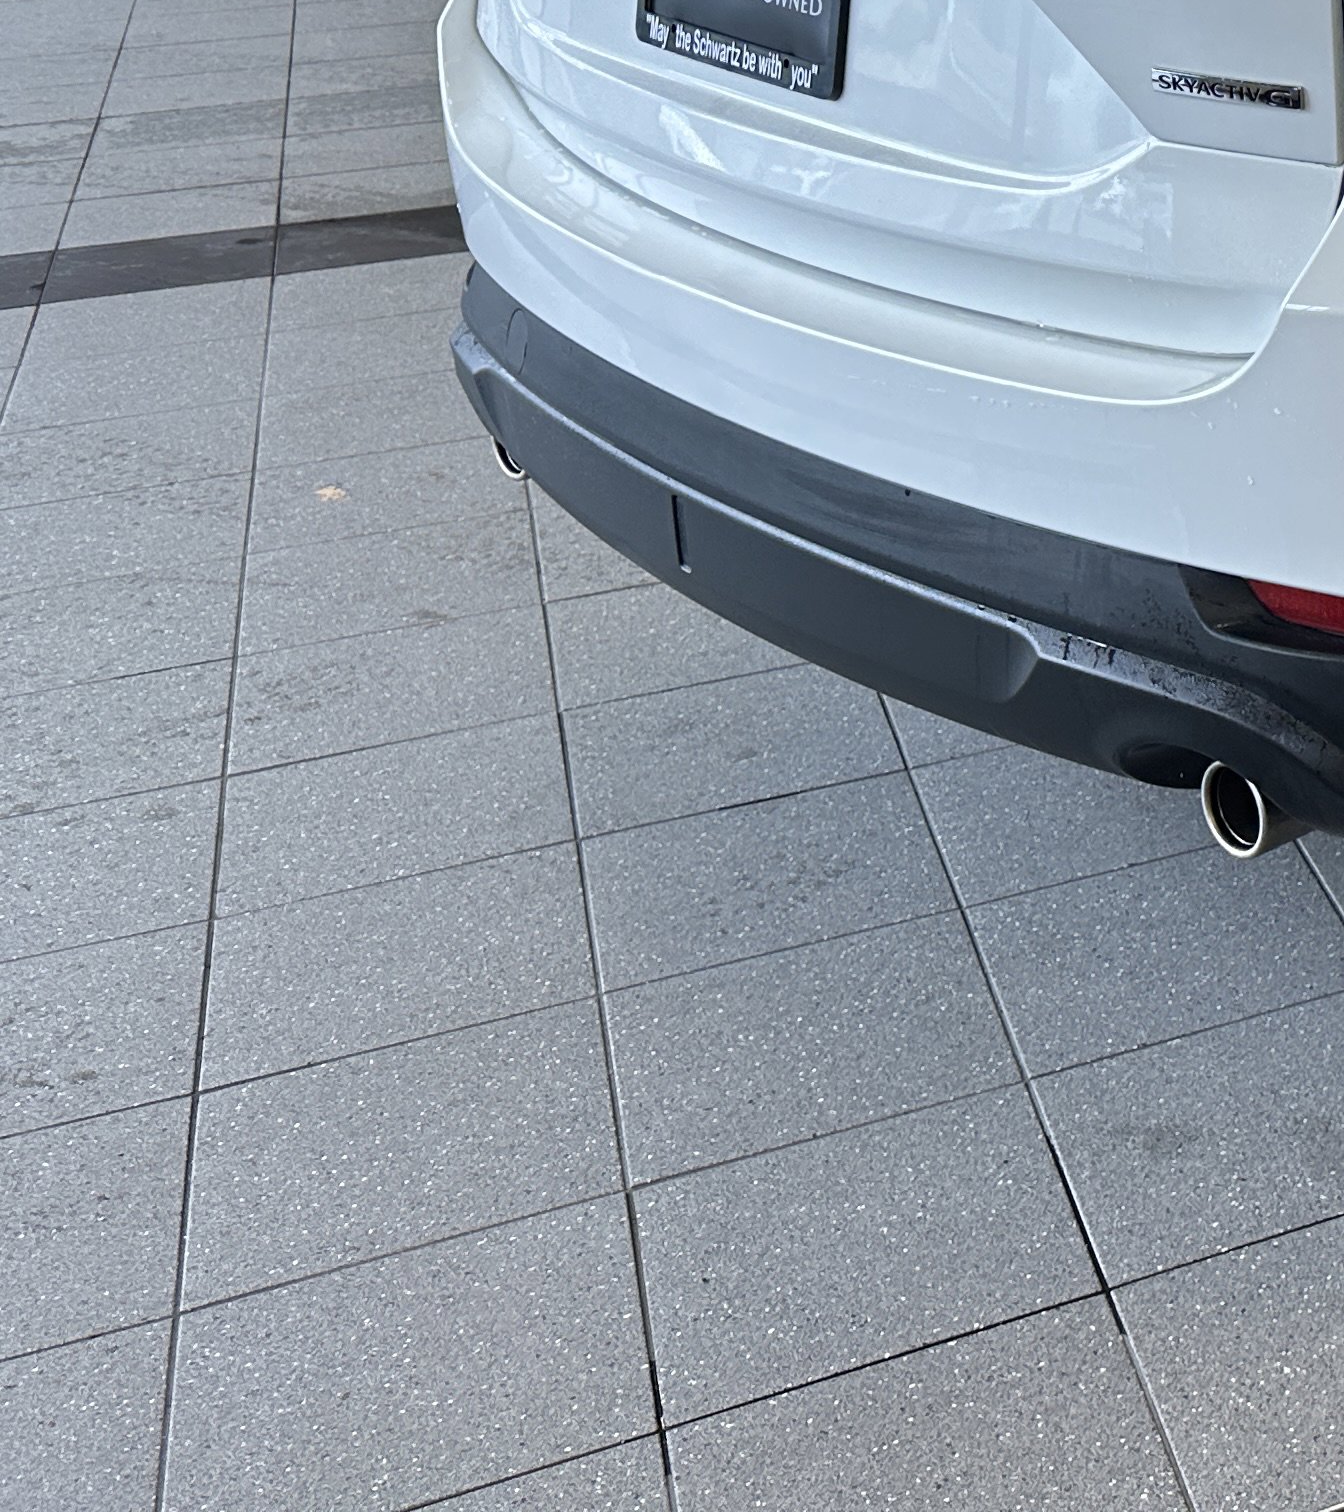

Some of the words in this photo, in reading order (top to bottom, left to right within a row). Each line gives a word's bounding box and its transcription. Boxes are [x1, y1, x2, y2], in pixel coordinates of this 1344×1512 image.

[675, 23, 691, 51] the
[692, 28, 741, 68] Schwartz
[742, 45, 756, 72] be
[758, 52, 783, 81] with
